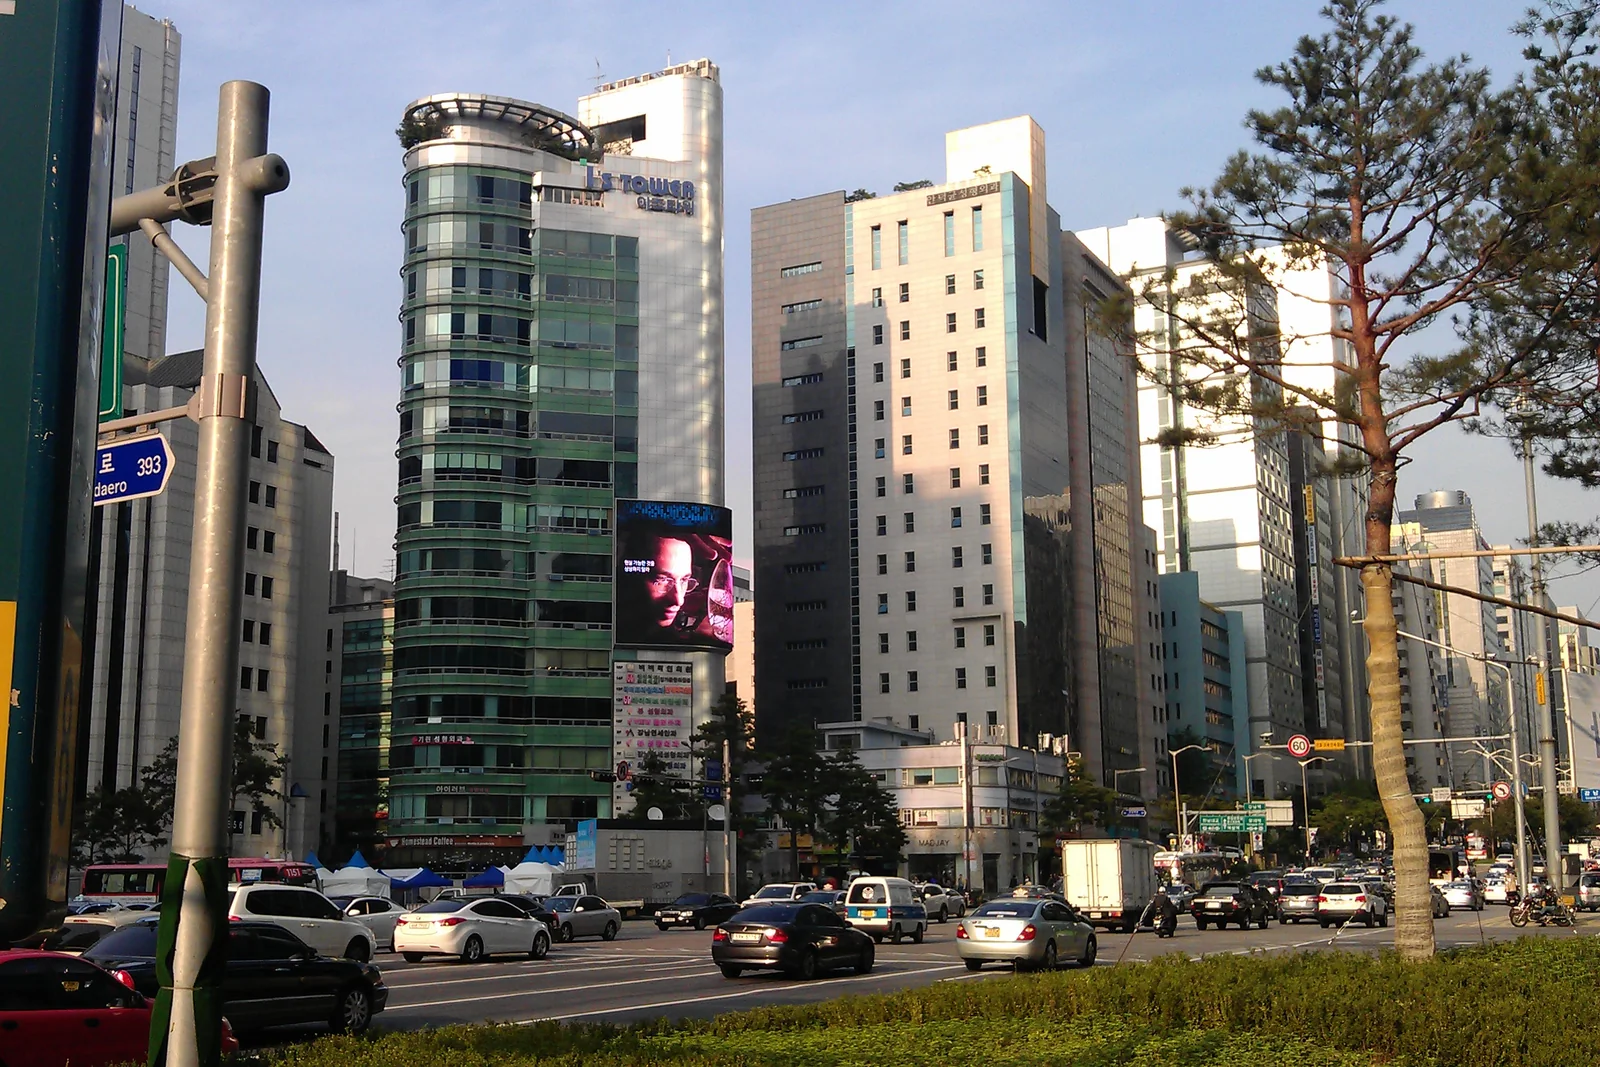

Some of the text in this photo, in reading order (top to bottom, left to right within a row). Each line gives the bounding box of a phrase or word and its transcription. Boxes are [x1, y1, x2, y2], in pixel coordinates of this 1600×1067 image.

[620, 174, 695, 199] TOWER
[136, 454, 162, 478] 393
[1292, 740, 1306, 751] 60
[433, 836, 454, 846] Coffee
